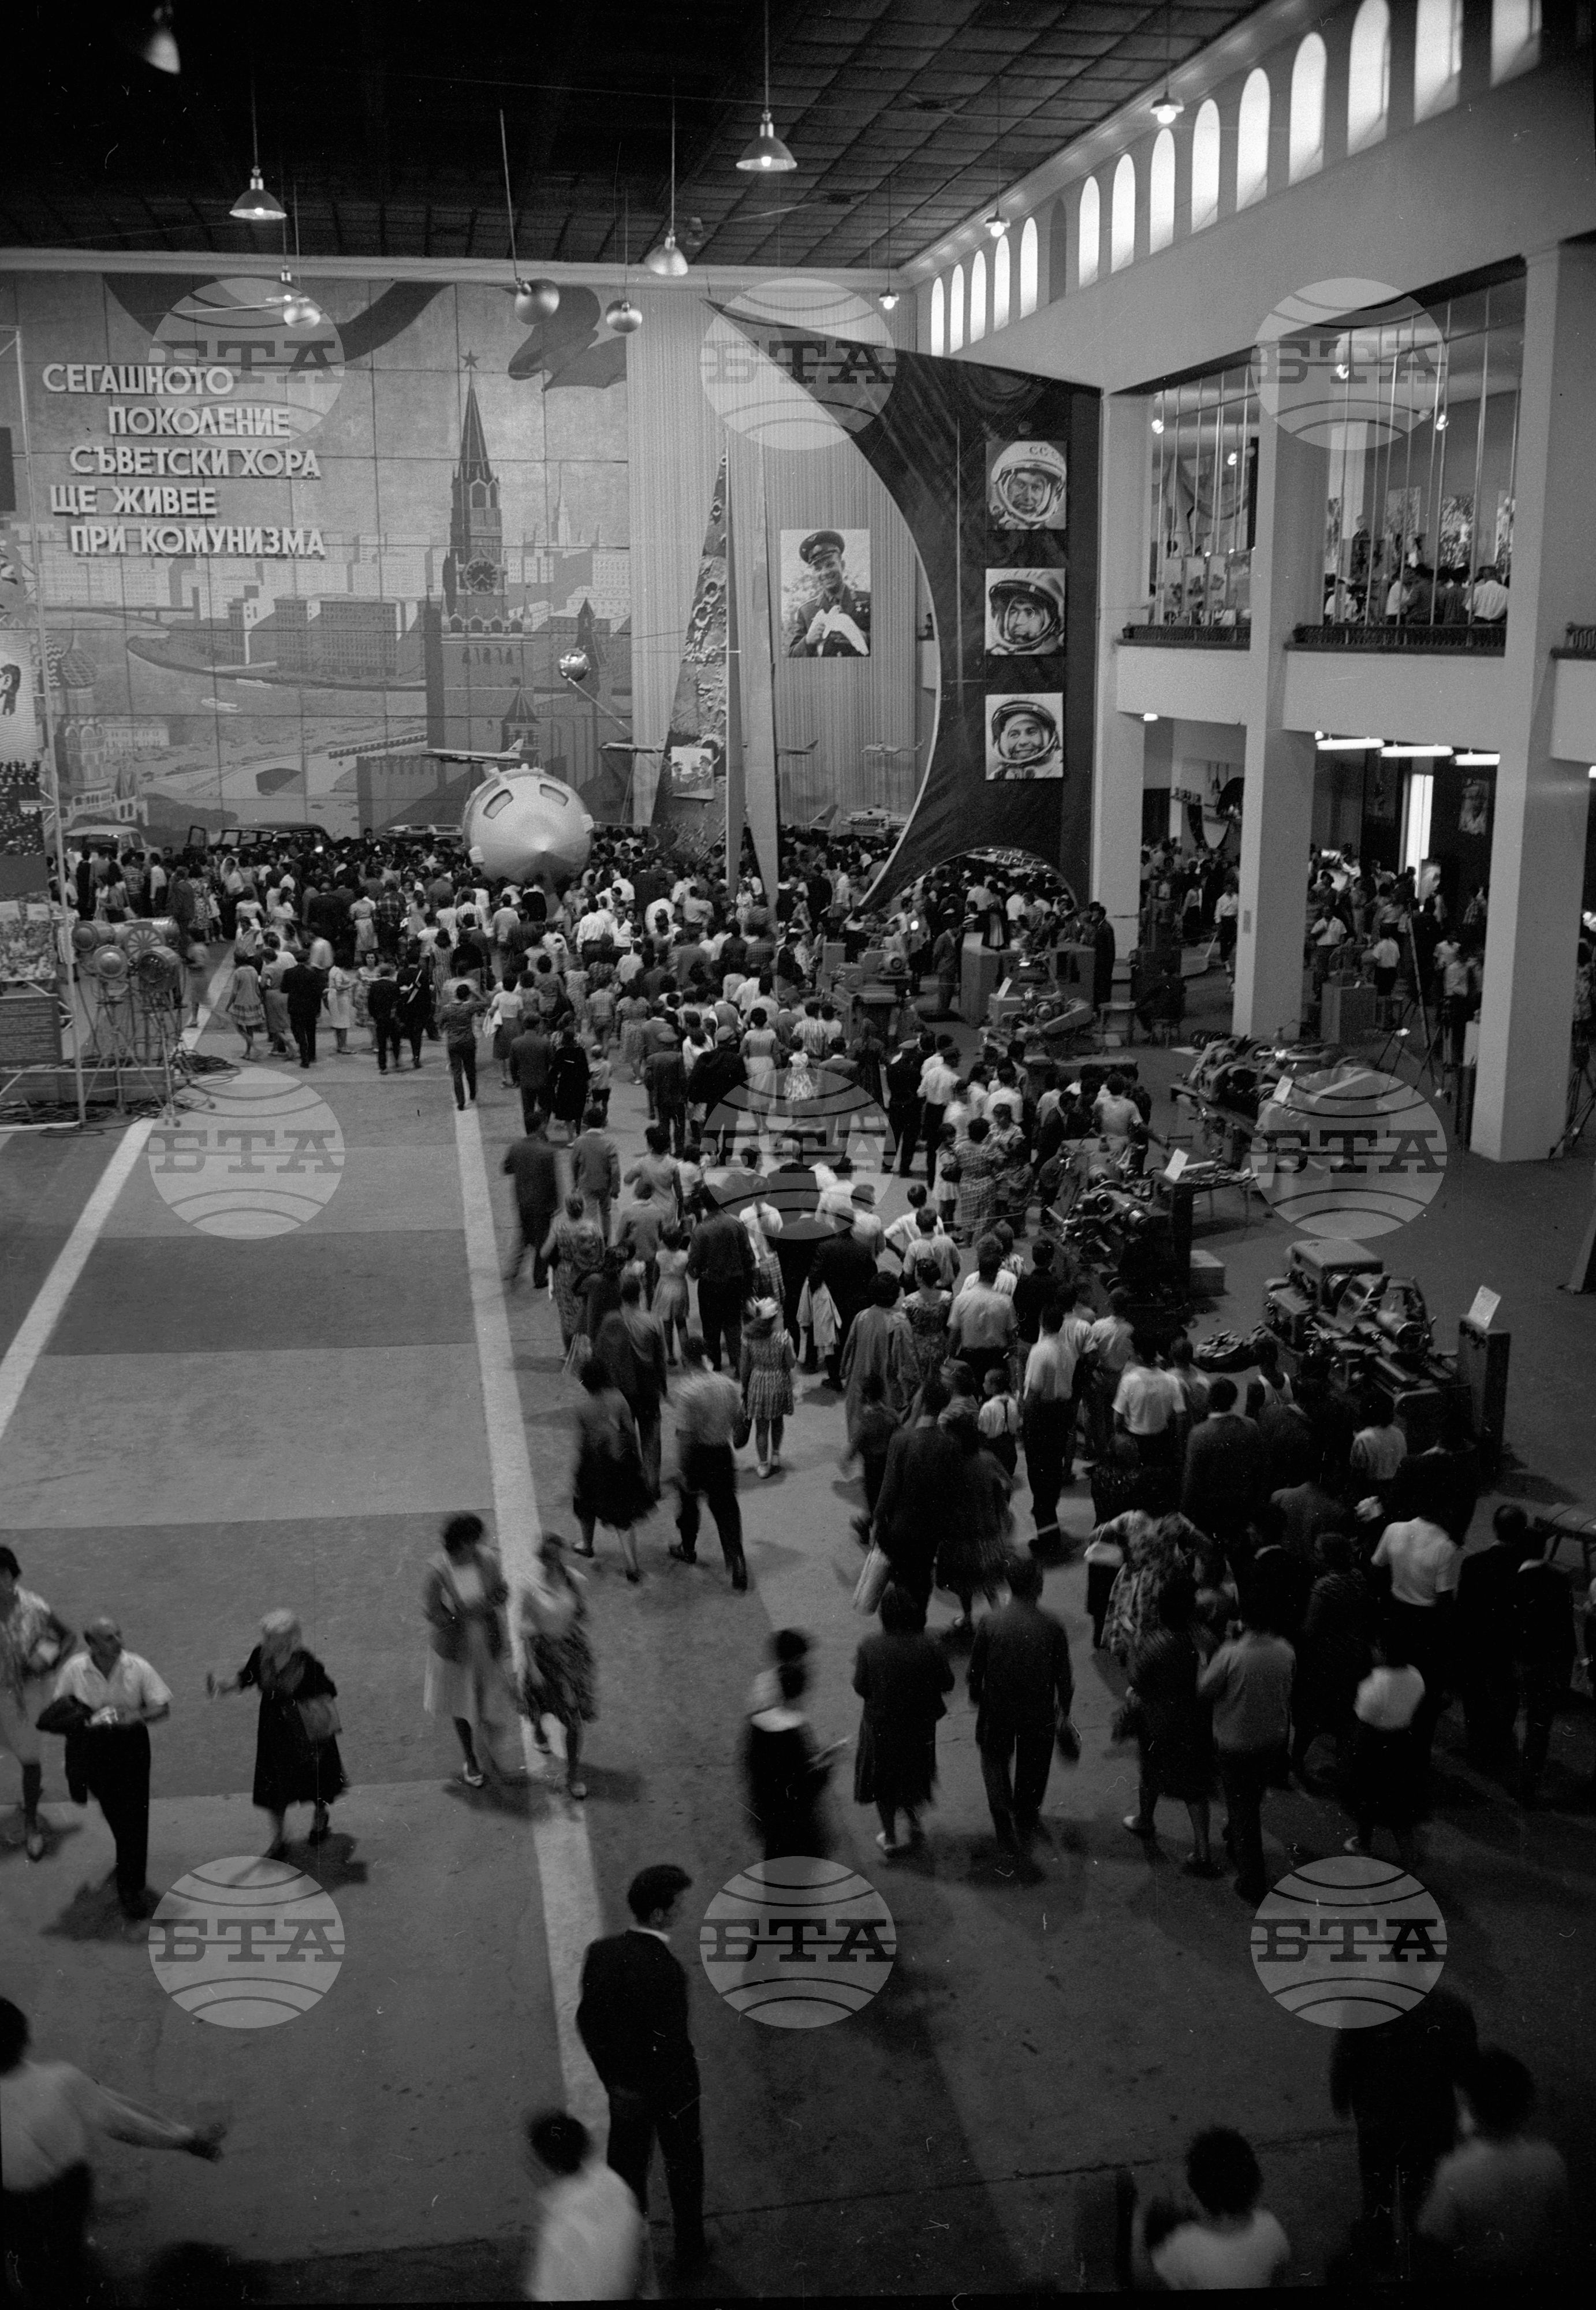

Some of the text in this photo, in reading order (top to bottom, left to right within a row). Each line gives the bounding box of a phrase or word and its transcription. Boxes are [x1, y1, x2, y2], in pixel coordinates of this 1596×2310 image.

[42, 363, 234, 394] СЕГАШНОТО
[108, 406, 290, 435] ПОКОЛЕНИЕ
[70, 445, 321, 477] СЪВЕТСКИ ХОРА
[50, 485, 217, 515] ЩЕ ЖИВЕЕ
[70, 526, 326, 556] ПРИ КОМУНИЗМА
